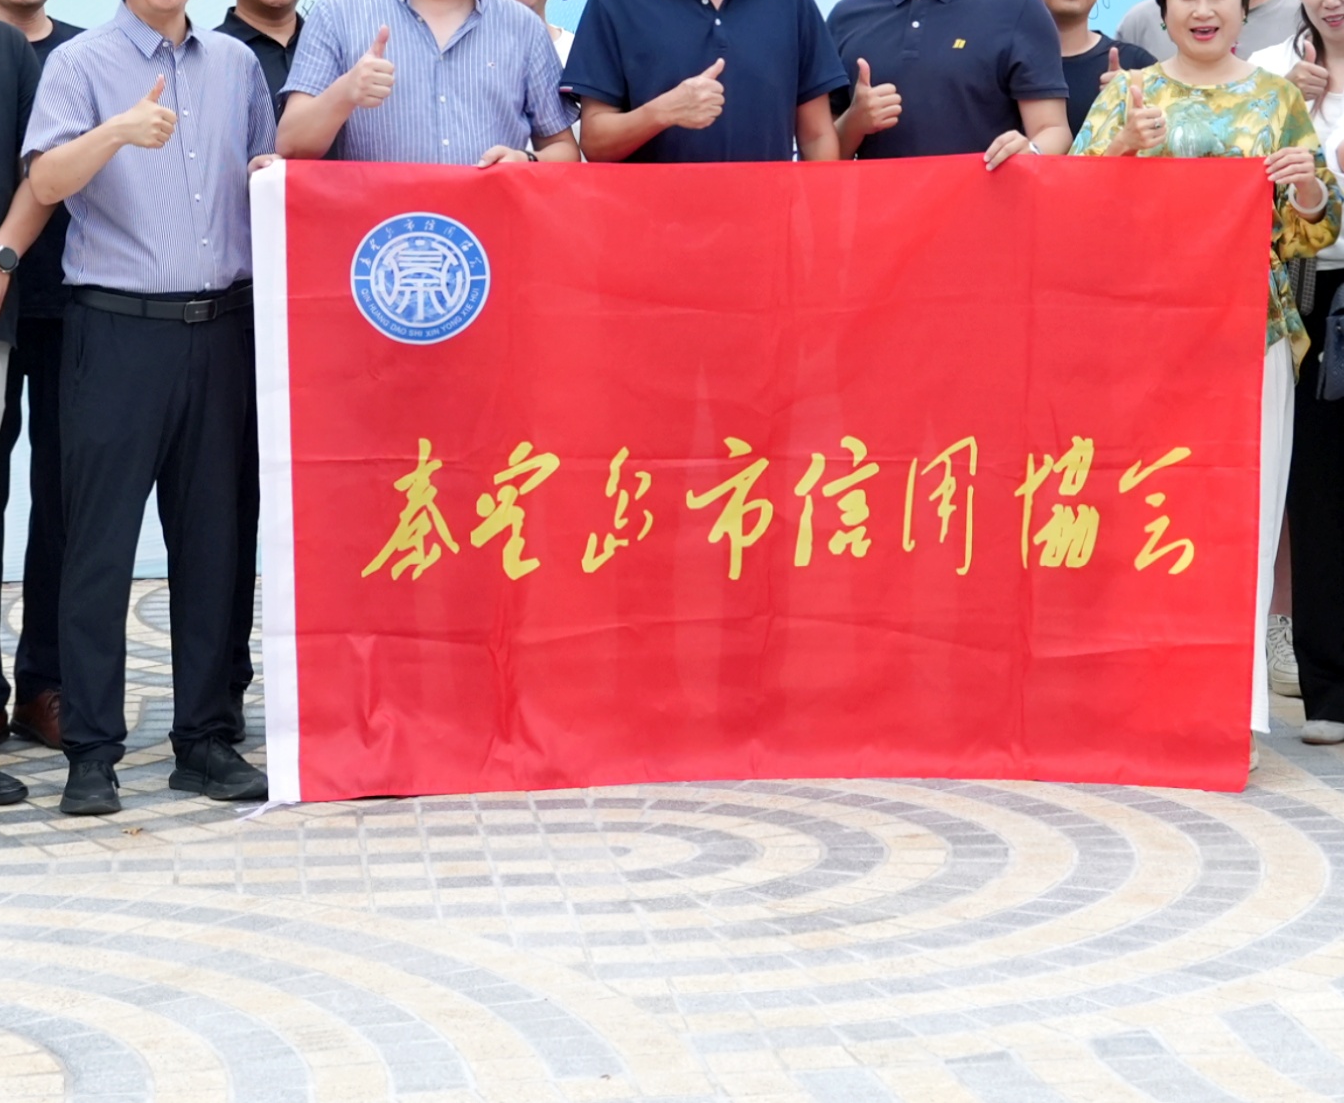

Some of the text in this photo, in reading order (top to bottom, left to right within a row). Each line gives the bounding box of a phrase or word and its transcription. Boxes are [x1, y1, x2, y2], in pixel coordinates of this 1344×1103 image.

[361, 288, 372, 303] QIN
[368, 302, 390, 327] HUANG
[390, 323, 407, 336] DAO
[425, 328, 440, 337] XIN
[441, 316, 463, 332] YONG
[462, 303, 474, 316] XIE
[471, 288, 481, 303] HUI
